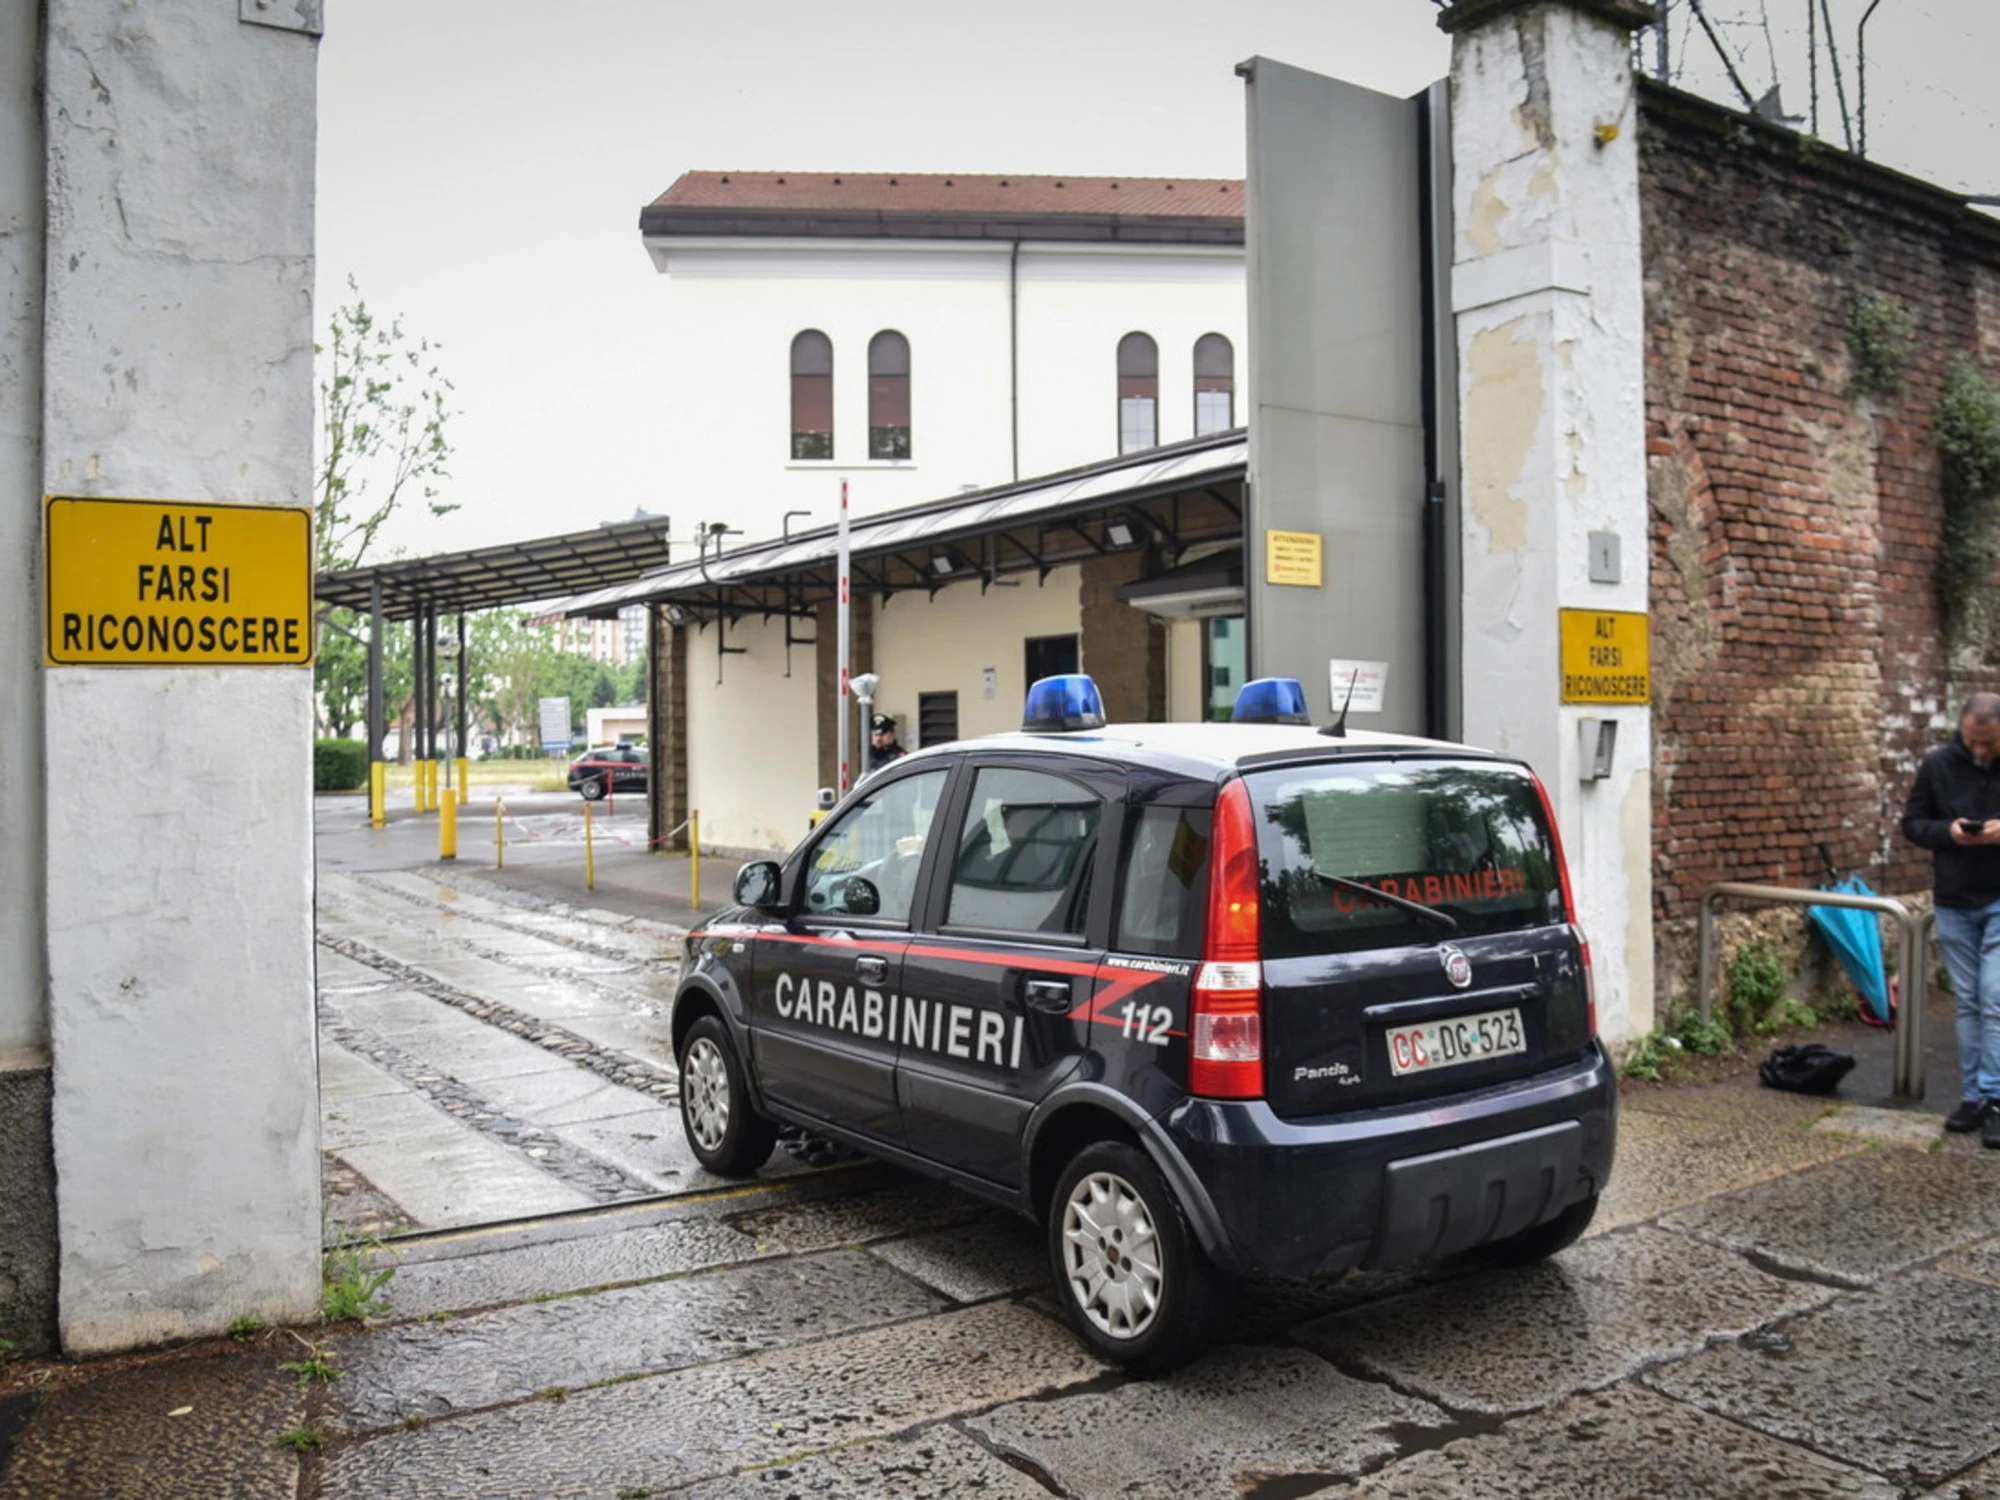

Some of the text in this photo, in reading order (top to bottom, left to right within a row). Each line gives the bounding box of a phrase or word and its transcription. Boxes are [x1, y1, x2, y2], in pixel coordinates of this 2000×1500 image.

[156, 514, 213, 553] ALT
[138, 565, 230, 603] FARSI
[63, 613, 300, 653] RICONOSCERE
[1595, 617, 1616, 638] ALT
[1589, 646, 1622, 667] FARSI
[1565, 675, 1646, 697] RICONOSCERE
[775, 972, 1024, 1069] CARABINIERI
[1121, 1001, 1173, 1046] 112
[1294, 1062, 1349, 1081] Panda
